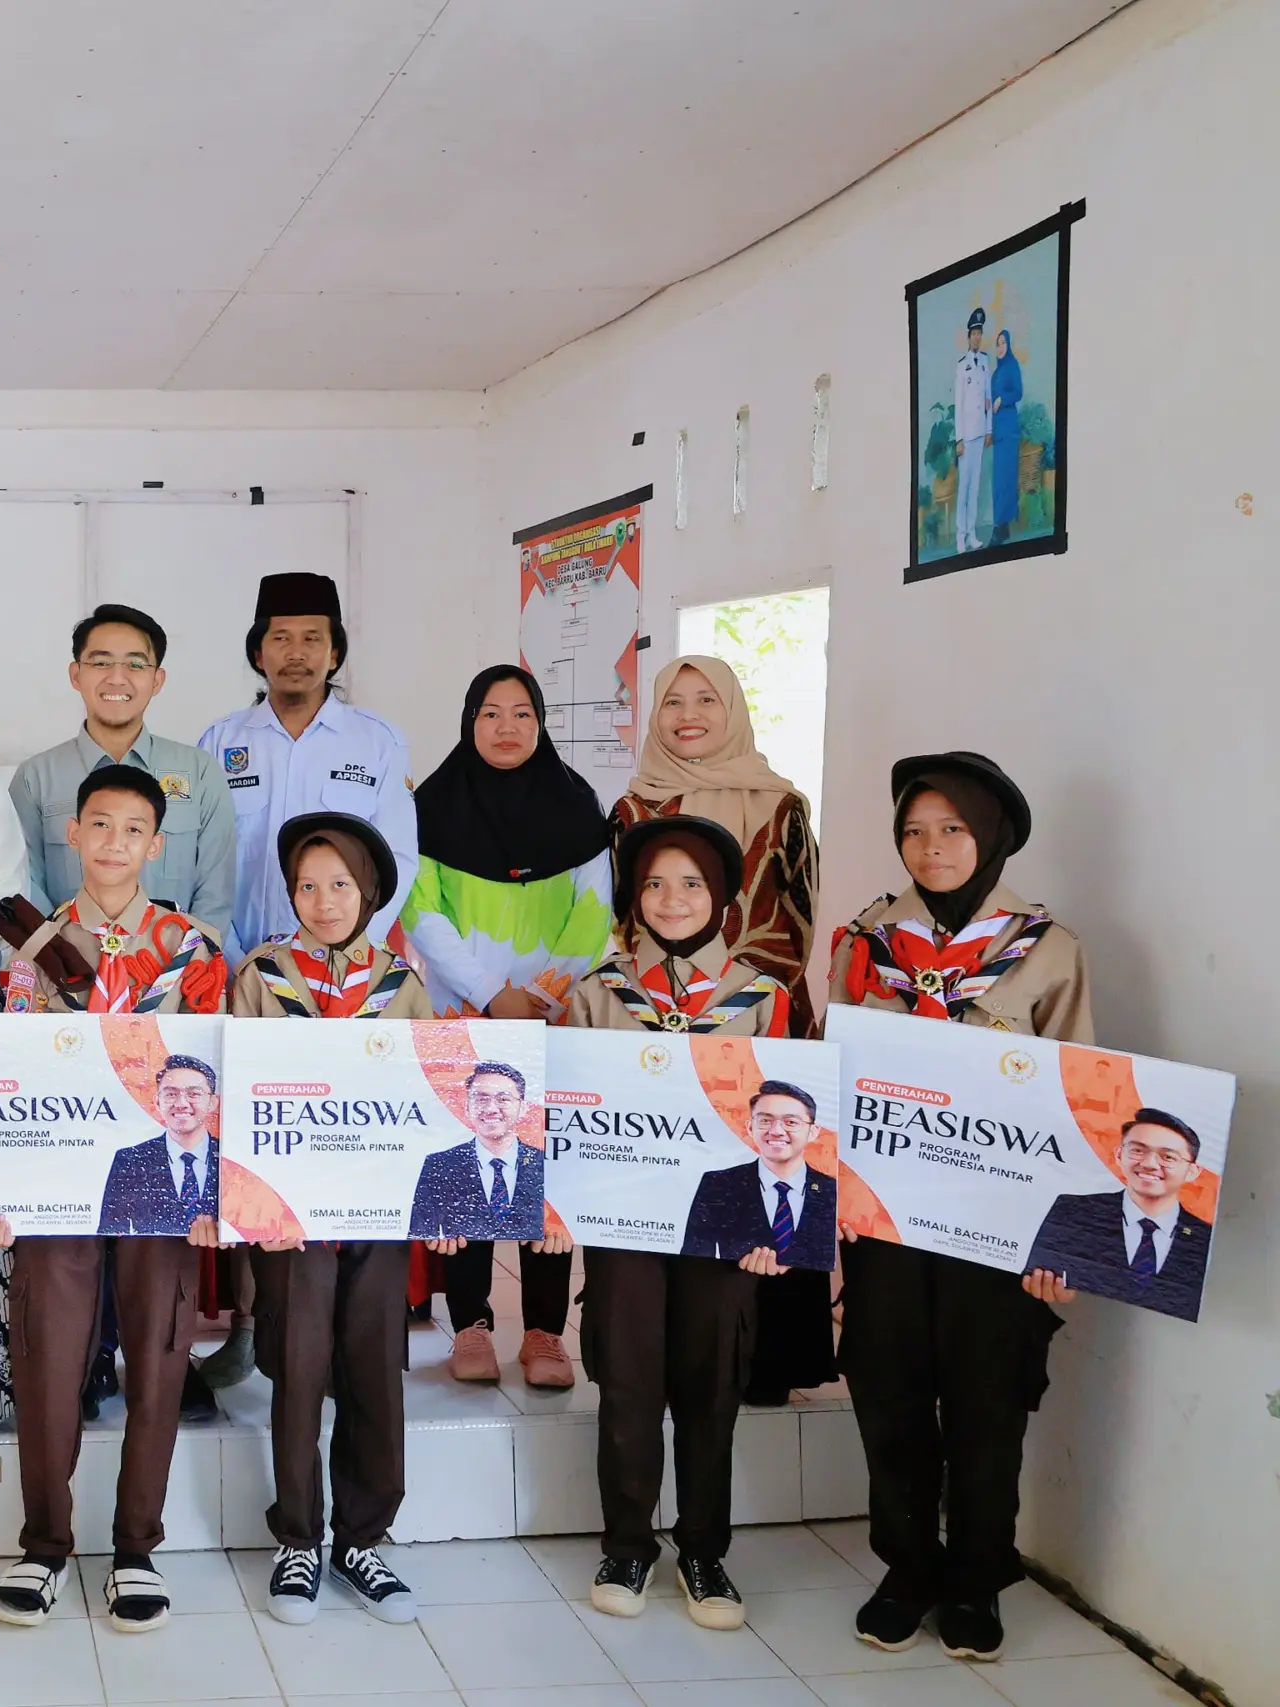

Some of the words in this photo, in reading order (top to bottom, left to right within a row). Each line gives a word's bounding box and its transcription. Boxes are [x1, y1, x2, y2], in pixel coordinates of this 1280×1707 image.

[557, 564, 570, 575] DESA
[571, 558, 593, 571] GALUNG
[556, 574, 574, 587] BARRU
[575, 570, 588, 581] KAB.
[588, 565, 607, 578] BARRU
[344, 764, 366, 773] DPC
[336, 772, 371, 784] APDESI
[257, 1085, 325, 1094] PENYERAHAN
[862, 1081, 944, 1103] PENYERAHAN
[545, 1094, 596, 1104] YERAHAN
[252, 1100, 427, 1126] BEASISWA
[545, 1108, 706, 1142] EASISWA
[854, 1094, 1066, 1163] BEASISWA
[58, 1138, 95, 1147] PINTAR
[252, 1130, 304, 1156] PIP
[310, 1134, 361, 1142] PROGRAM
[850, 1124, 911, 1158] PIP
[310, 1143, 367, 1152] INDONESIA
[369, 1143, 404, 1152] PINTAR
[579, 1142, 633, 1154] PROGRAM
[919, 1142, 981, 1162] PROGRAM
[579, 1152, 638, 1164] INDONESIA
[642, 1156, 681, 1167] PINTAR
[918, 1151, 986, 1173] INDONESIA
[990, 1166, 1033, 1184] PINTAR
[38, 1203, 92, 1212] BACHTIAR
[310, 1208, 345, 1218] ISMAIL
[348, 1208, 401, 1218] BACHTIAR
[576, 1215, 614, 1226] ISMAIL
[617, 1218, 675, 1232] BACHTIAR
[908, 1216, 950, 1235] ISMAIL
[954, 1226, 1019, 1250] BACHTIAR
